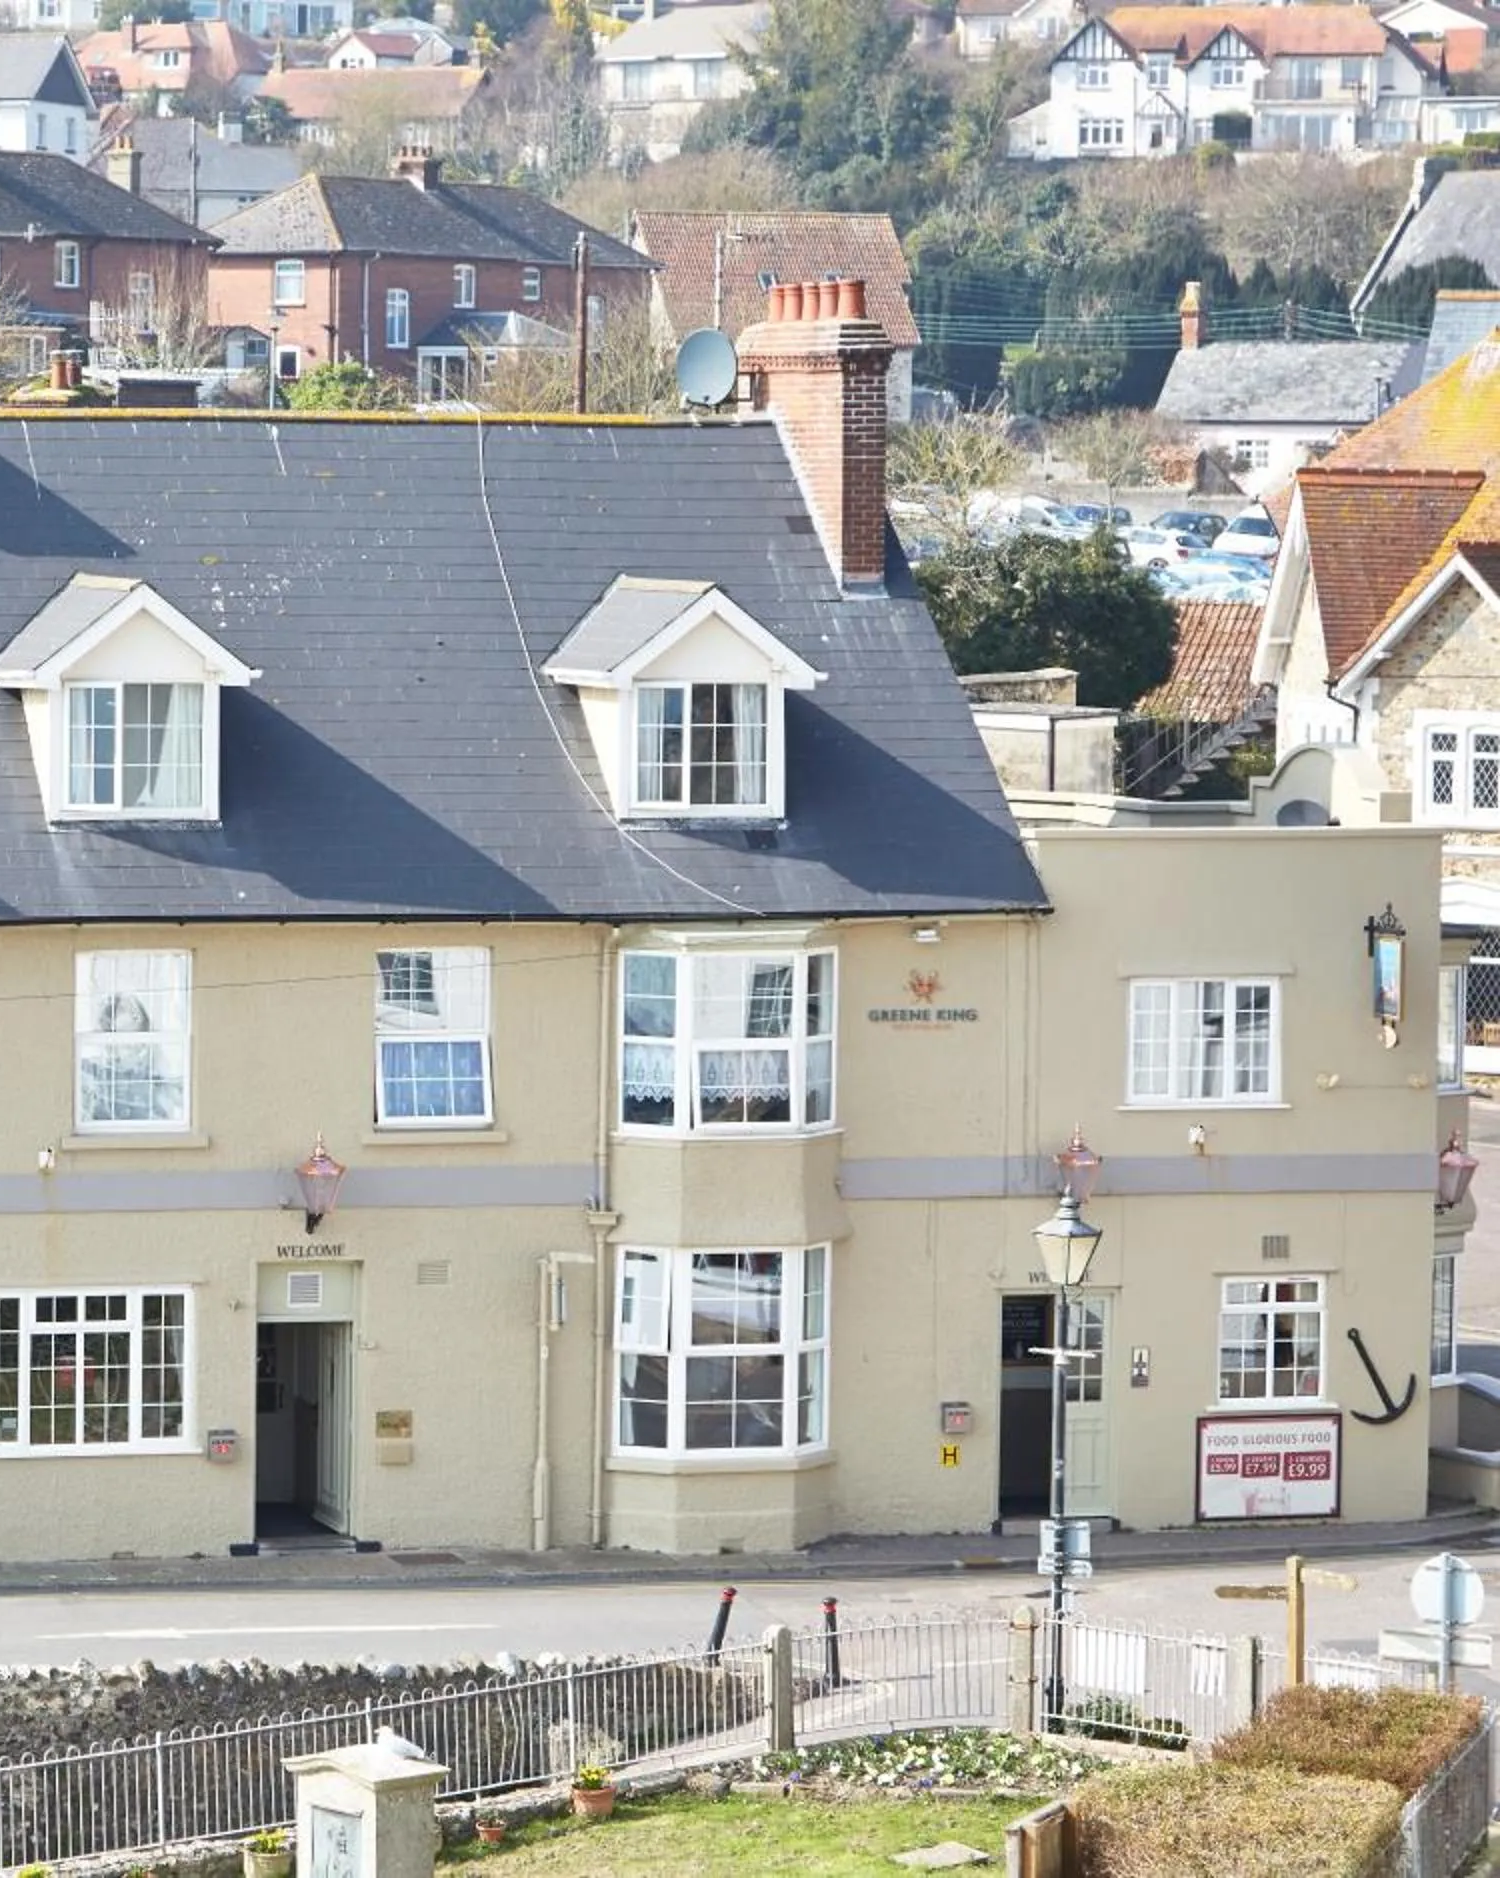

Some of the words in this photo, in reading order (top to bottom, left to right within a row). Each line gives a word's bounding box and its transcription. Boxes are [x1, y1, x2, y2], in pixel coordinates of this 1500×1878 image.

[868, 1008, 931, 1022] GREENE
[936, 1008, 979, 1022] KING
[276, 1243, 345, 1258] WELCOME
[1207, 1435, 1239, 1447] FOOD
[1243, 1433, 1298, 1445] GLORIOUS
[1301, 1431, 1331, 1443] FOOD
[943, 1447, 957, 1465] H
[1245, 1462, 1277, 1473] £7.99
[1288, 1462, 1327, 1478] £9.99
